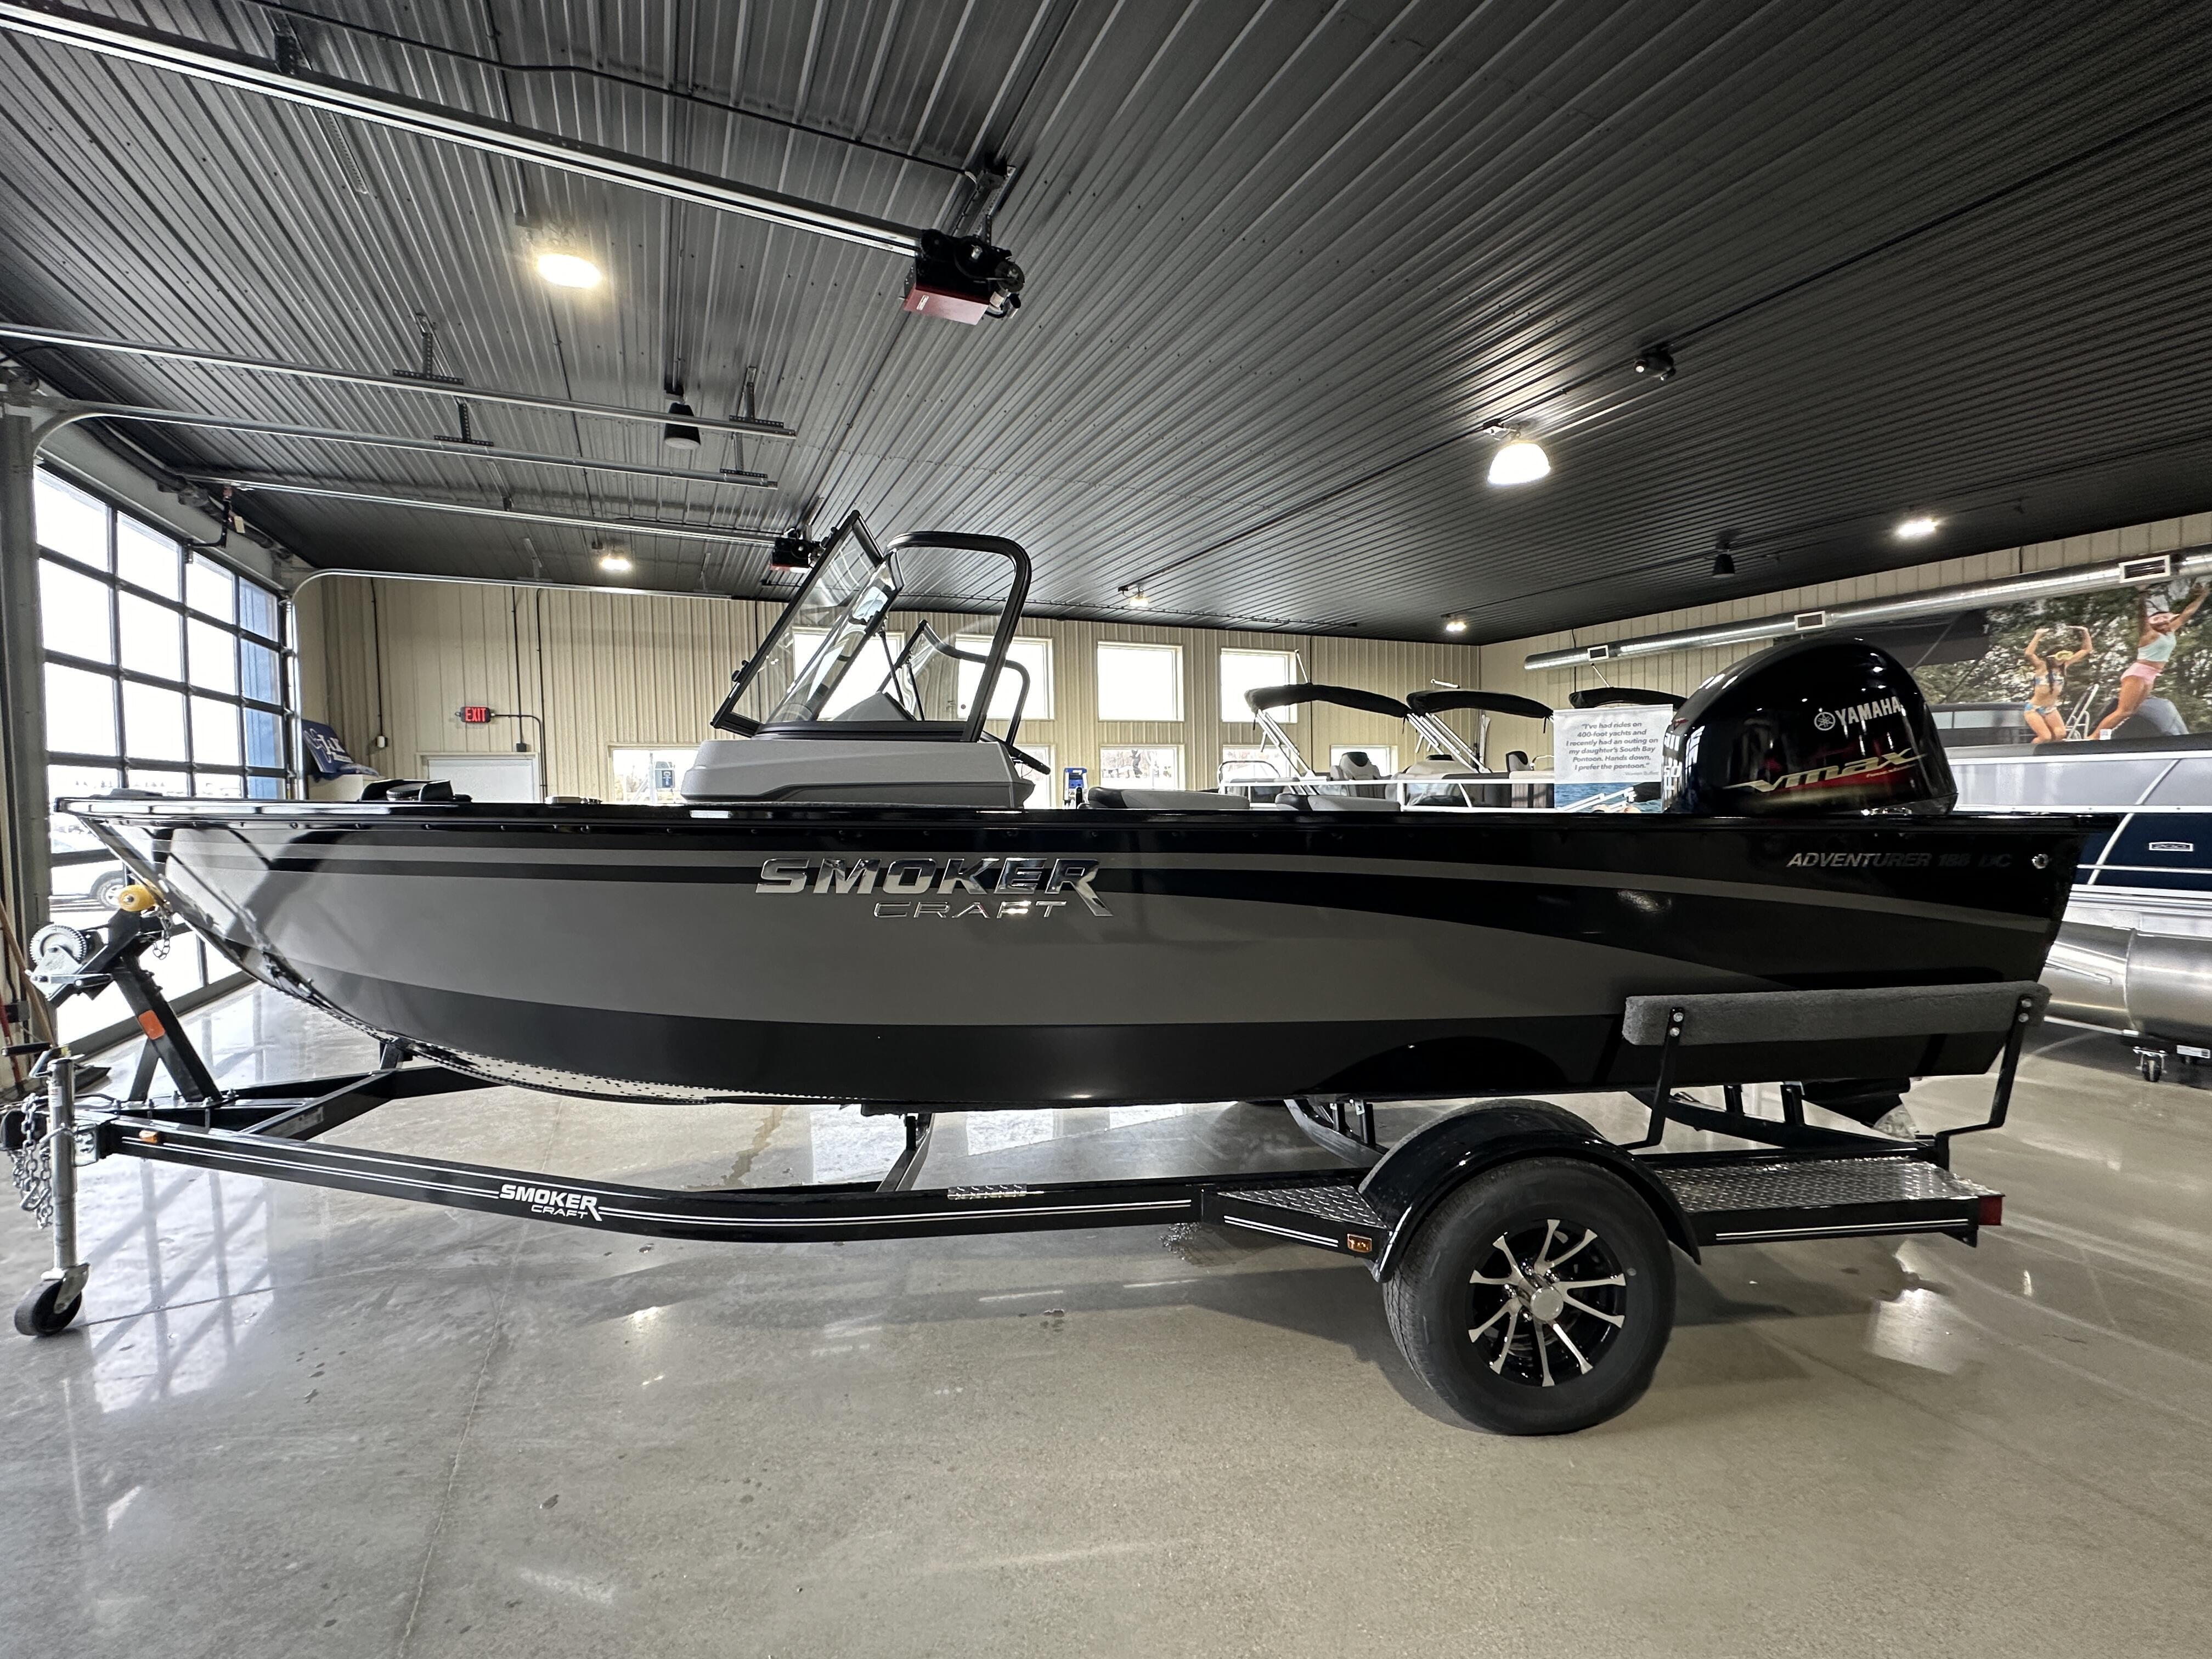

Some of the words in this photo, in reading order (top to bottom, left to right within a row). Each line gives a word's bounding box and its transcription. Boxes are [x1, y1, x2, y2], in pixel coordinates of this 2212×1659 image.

[465, 707, 486, 722] EXIT
[1835, 696, 1901, 726] YAMAHA
[1786, 853, 1932, 867] ADVENTURER
[1978, 853, 2013, 868] DC
[755, 857, 1114, 917] SMOKER
[873, 900, 1068, 918] CRAFT
[499, 1184, 602, 1222] SMOKER
[531, 1204, 588, 1219] CRAFT
